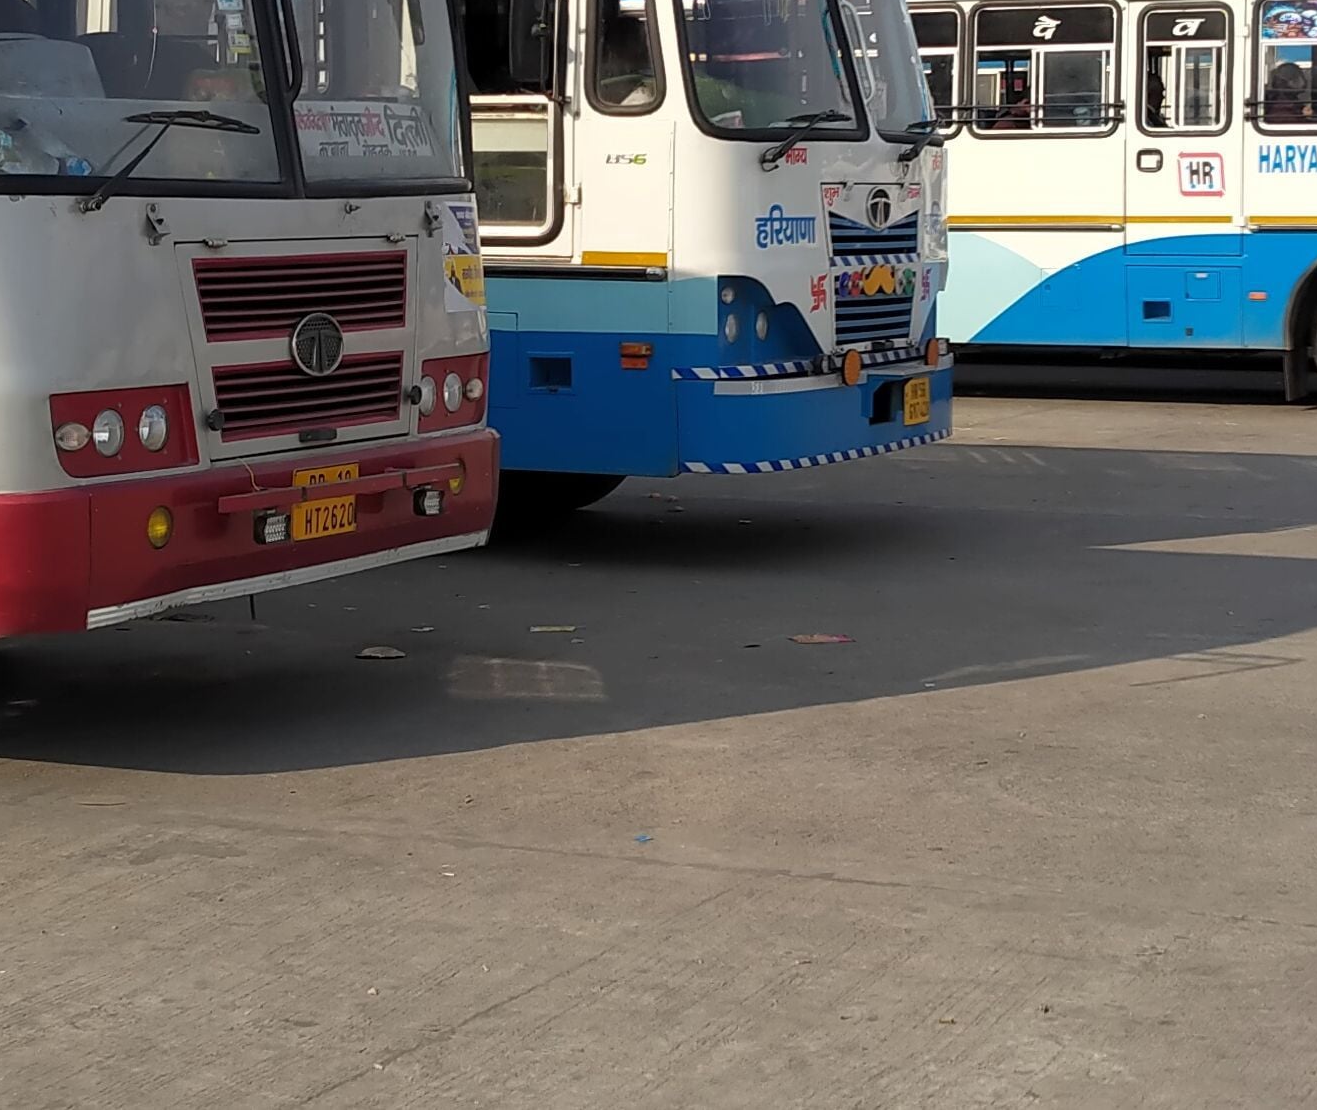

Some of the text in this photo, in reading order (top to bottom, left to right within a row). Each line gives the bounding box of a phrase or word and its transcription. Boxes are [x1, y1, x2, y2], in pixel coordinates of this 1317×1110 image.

[1187, 160, 1215, 189] HR
[755, 204, 817, 249] हरियाणा
[305, 501, 355, 536] HT2620
